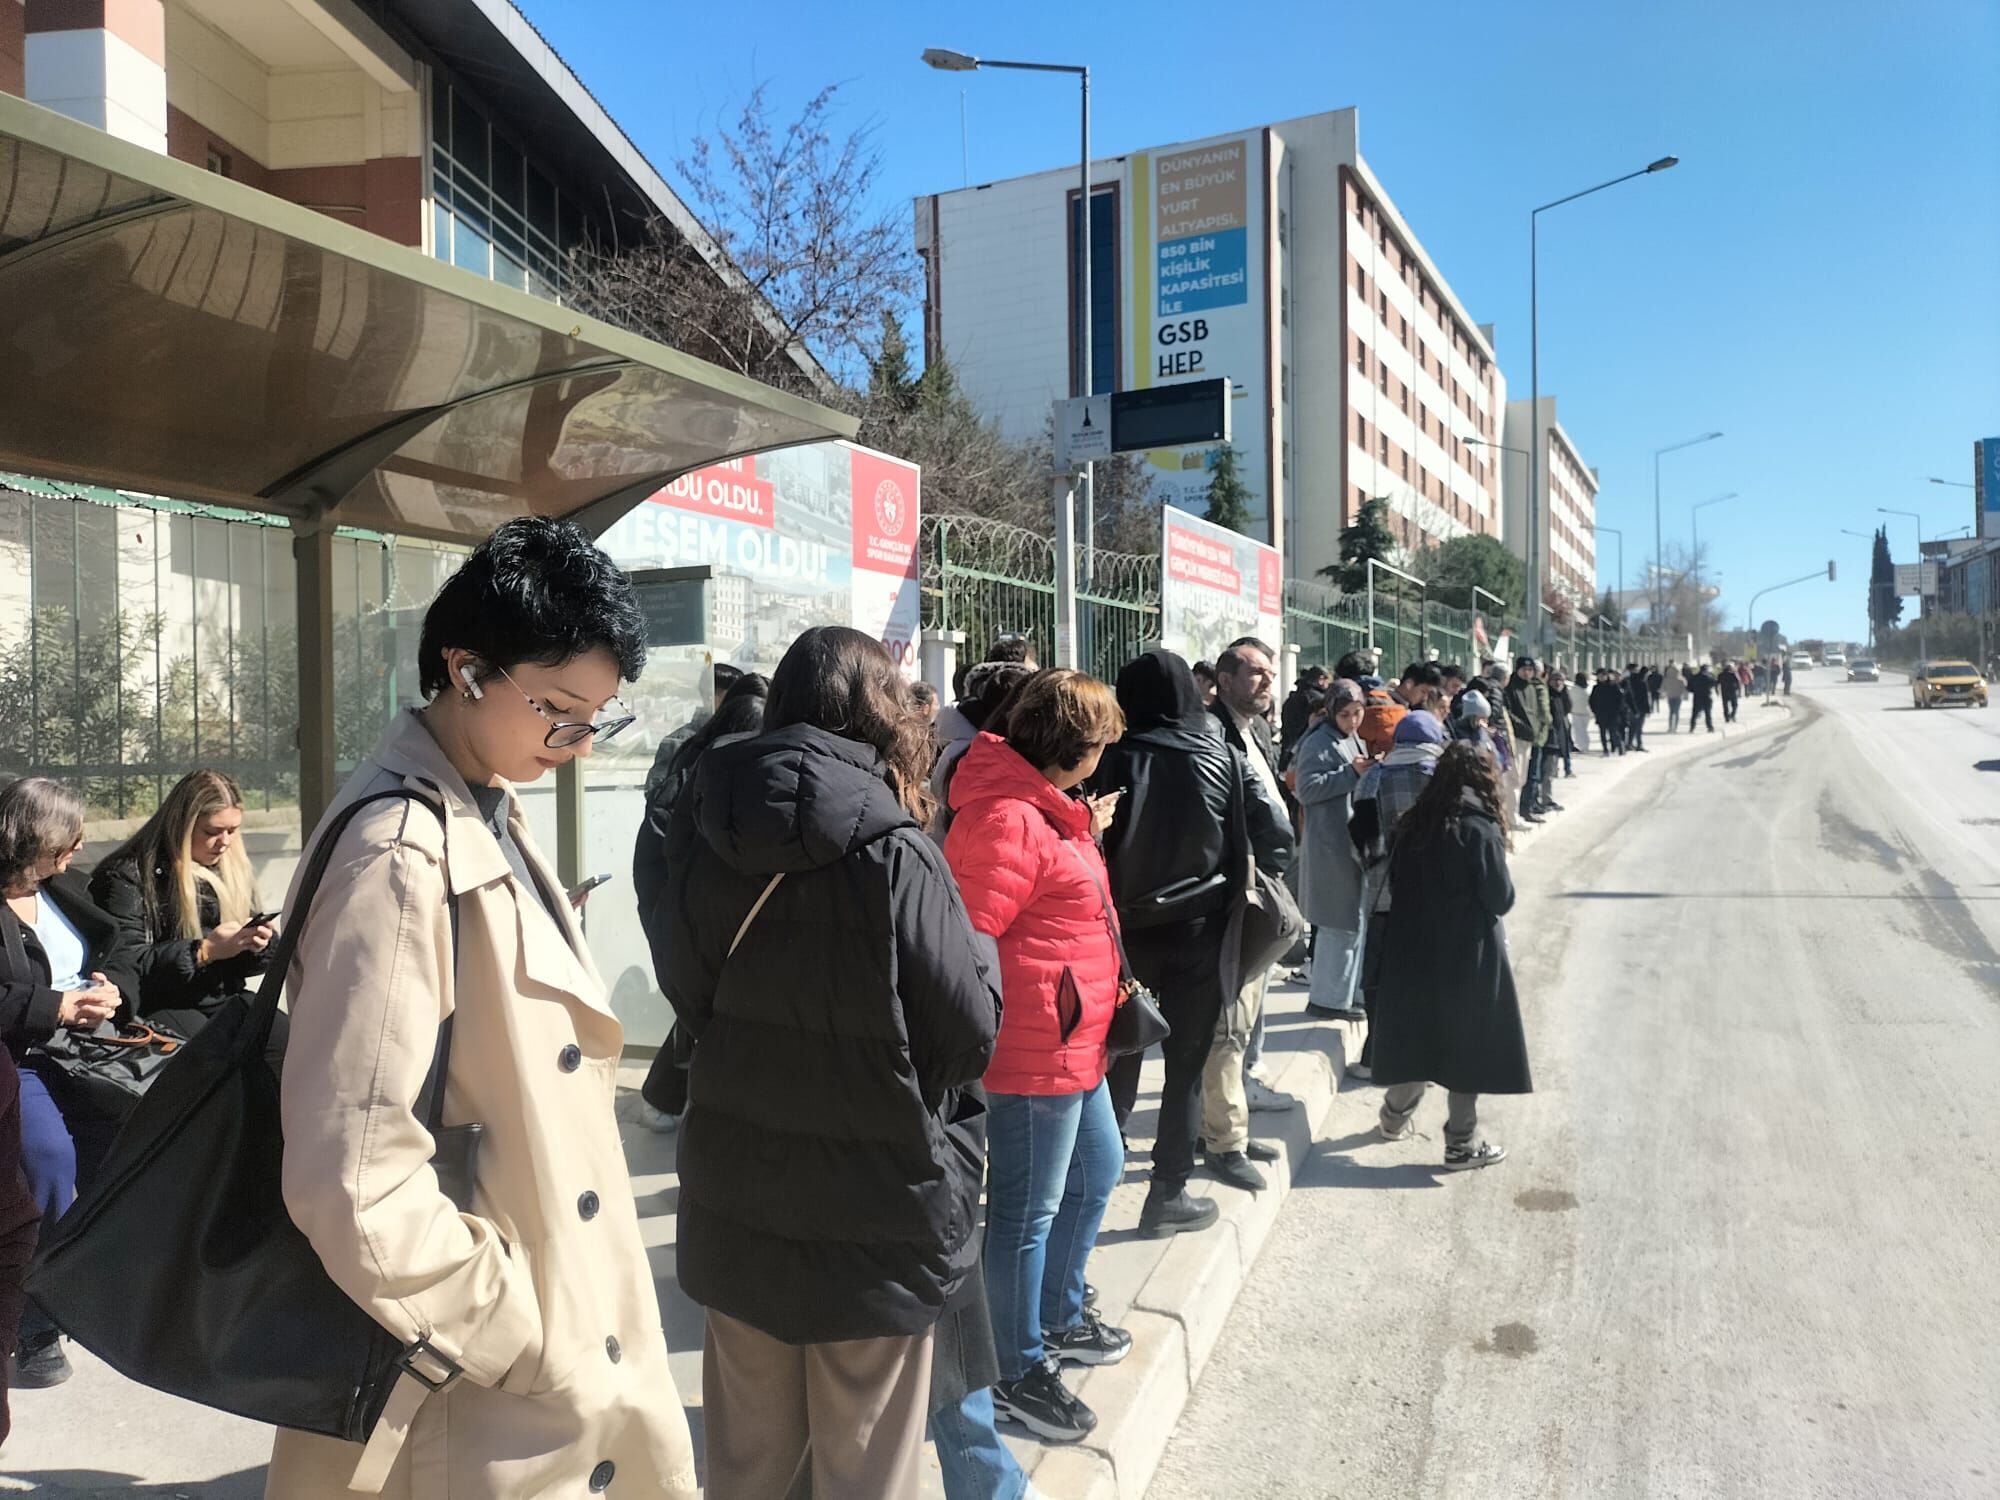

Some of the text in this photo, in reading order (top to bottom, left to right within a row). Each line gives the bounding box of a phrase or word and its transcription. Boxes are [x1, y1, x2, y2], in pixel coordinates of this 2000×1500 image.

[1160, 147, 1240, 174] DÜNYANIN
[1160, 168, 1236, 195] EN BÜYÜK
[1160, 198, 1200, 216] YURT
[1160, 237, 1216, 259] 850 BİN
[1160, 256, 1211, 279] KİŞİLİK
[1160, 267, 1244, 297] KAPASİTESİ
[1160, 299, 1183, 315] İLE
[1158, 319, 1209, 346] GSB
[1158, 350, 1203, 377] HEP
[707, 479, 764, 516] OLDU.
[736, 528, 828, 582] OLDU!
